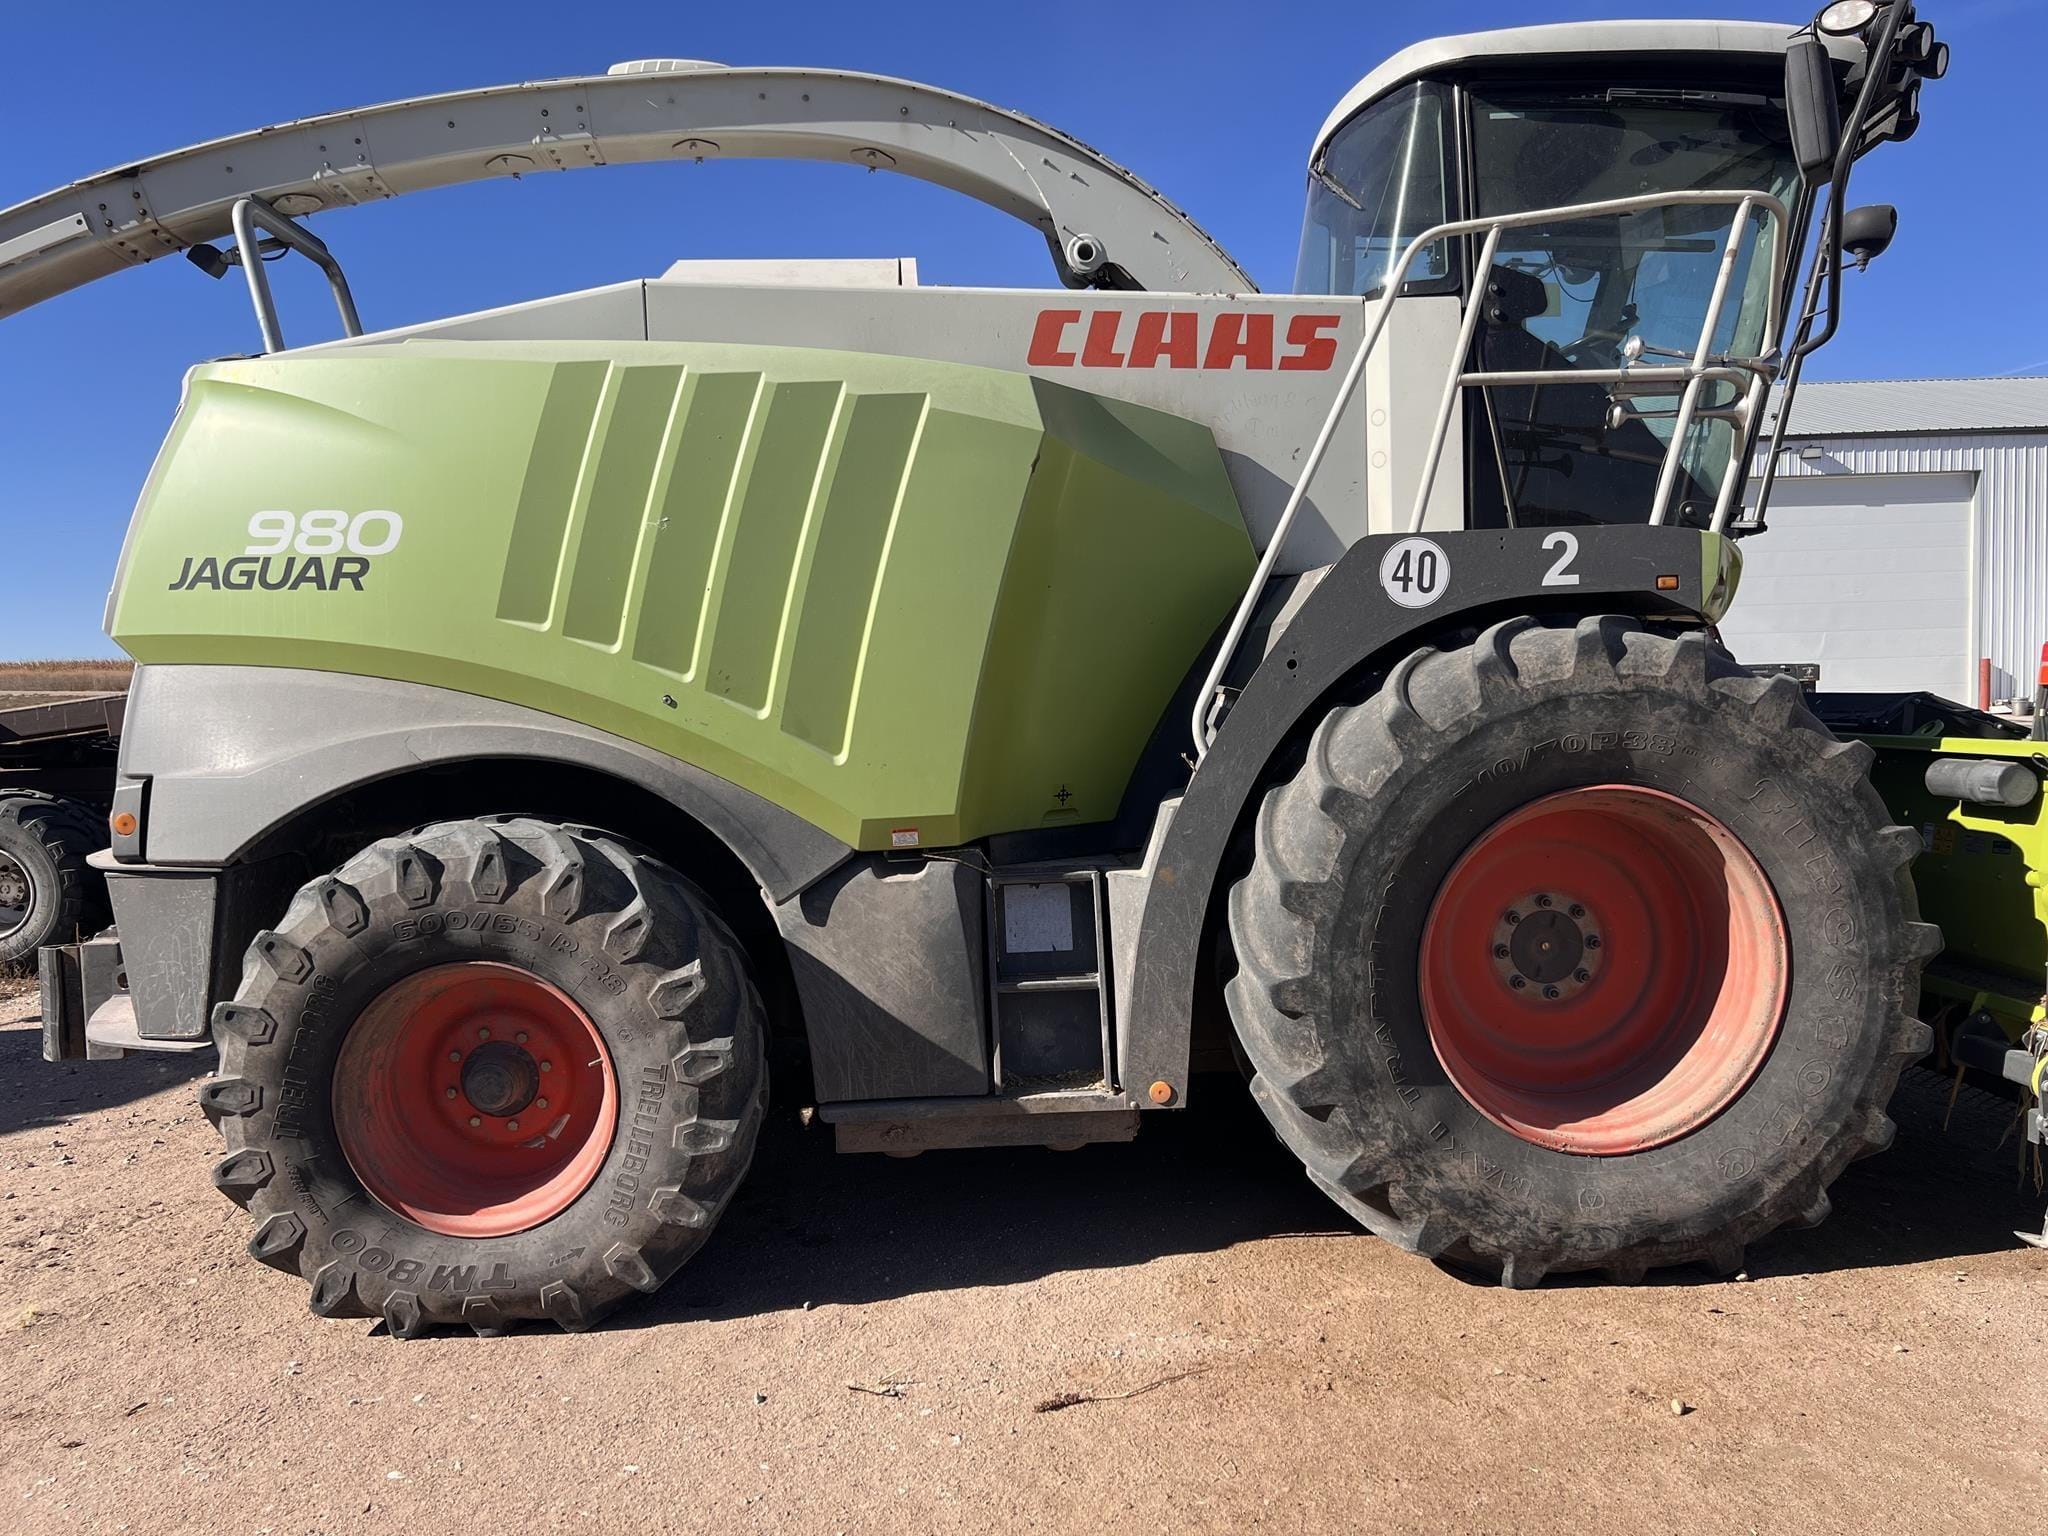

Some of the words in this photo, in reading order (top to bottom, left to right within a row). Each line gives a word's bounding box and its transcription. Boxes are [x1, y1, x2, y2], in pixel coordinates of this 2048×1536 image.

[1027, 309, 1341, 371] CLAAS
[244, 509, 403, 556] 980
[168, 556, 370, 591] JAGUAR
[1392, 549, 1437, 594] 40
[1541, 531, 1580, 587] 2
[391, 911, 544, 942] 600/65
[550, 932, 580, 958] R
[603, 1064, 669, 1229] TRELLEBORG
[330, 1229, 517, 1293] TM800
